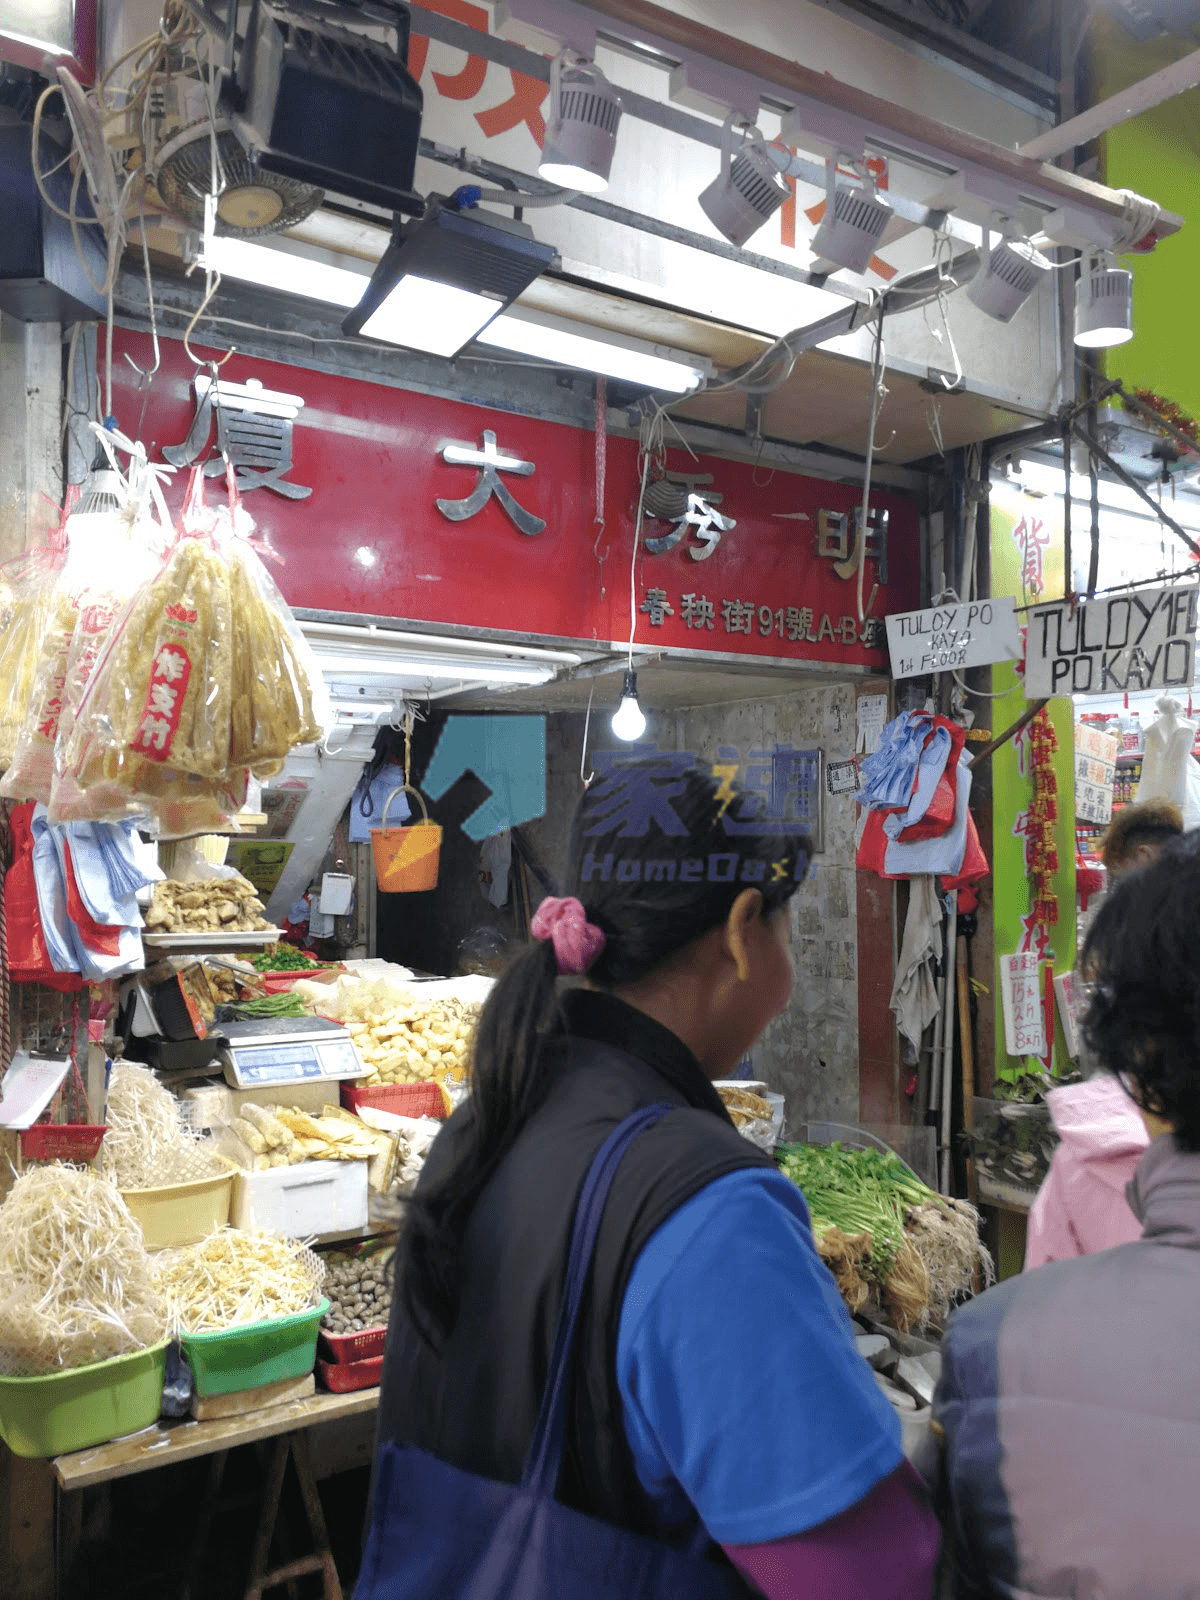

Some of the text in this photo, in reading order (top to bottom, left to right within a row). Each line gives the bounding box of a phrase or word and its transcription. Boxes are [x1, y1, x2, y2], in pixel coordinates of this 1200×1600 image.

[895, 604, 993, 637] TULOY PO
[931, 630, 971, 650] KAYO
[1034, 591, 1165, 658] TULOY
[899, 649, 967, 674] 1st FLOOR
[1052, 640, 1190, 693] PO KAYO
[141, 647, 187, 750] 炸支竹
